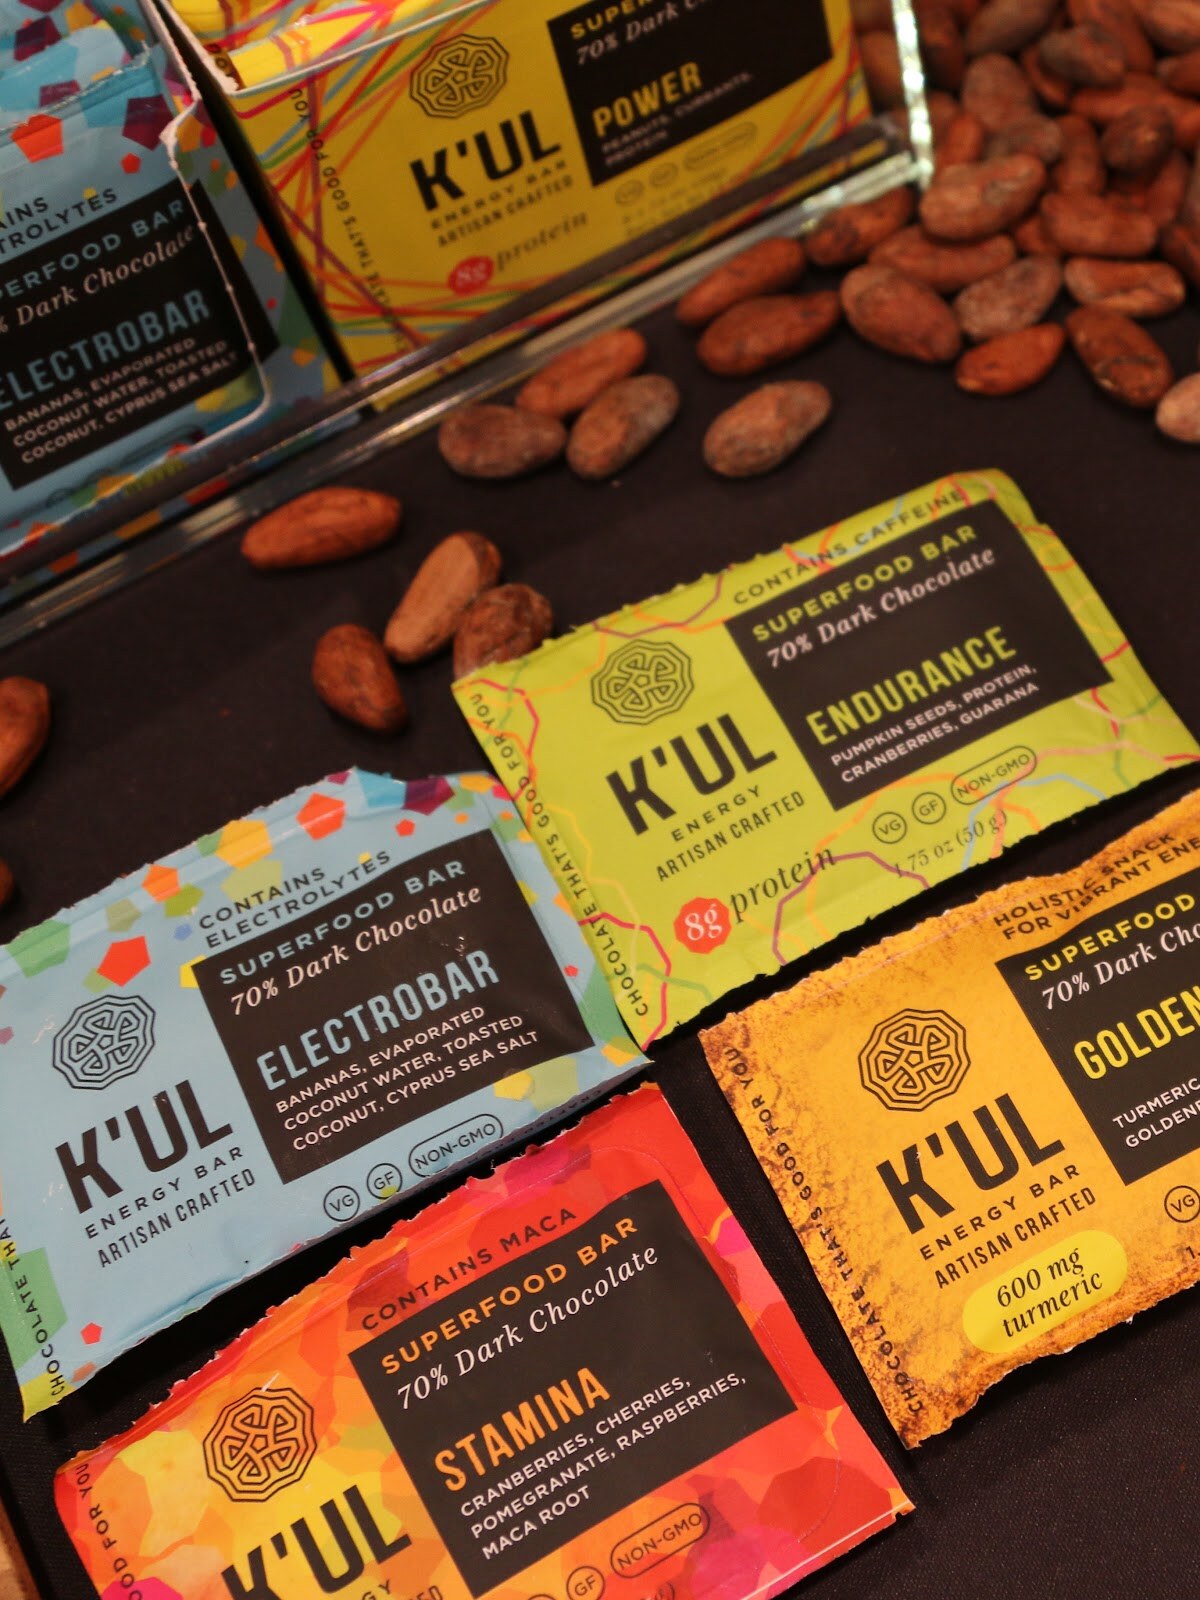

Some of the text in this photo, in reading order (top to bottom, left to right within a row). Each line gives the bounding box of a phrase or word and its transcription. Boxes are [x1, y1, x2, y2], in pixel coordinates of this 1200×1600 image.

[592, 61, 702, 137] POWER
[306, 128, 351, 213] GOOD FOR
[410, 110, 560, 211] K'UL
[431, 160, 567, 231] ENERGY BAR
[131, 200, 186, 239] BAR
[438, 206, 504, 248] ARTISAN
[17, 225, 196, 327] Dark Chocolate
[13, 340, 229, 449] COCONUT TOASTED
[89, 337, 196, 391] EVAPORATED
[105, 352, 237, 425] CYPRUS SEA SALT
[732, 488, 967, 606] CONTAINS CAFFEINE
[751, 524, 978, 643] SUPERFOOD BAR
[766, 547, 996, 670] 70% Dark Chocolate
[805, 626, 1017, 747] ENDURANCE
[831, 663, 1039, 767] PUMPKIN SEEDS, PROTEIN,
[840, 682, 1040, 783] CRANBERRIES, GUARANA
[605, 712, 778, 837] K'UL
[670, 785, 762, 842] ENERGY
[878, 752, 1031, 836] VG GF NON-GMO
[469, 692, 650, 1019] CHOCOLATE THAT'S GOOD FOR YOU
[655, 790, 806, 882] ARTISAN CRAFTED
[993, 832, 1176, 929] HOLISTIC SNACK
[198, 867, 327, 930] CONTAINS
[204, 850, 392, 949] ELECTROLYTES
[219, 860, 467, 986] SUPERFOOD BAR
[684, 847, 838, 942] 8g protein
[1002, 916, 1052, 942] FOR
[1053, 861, 1156, 927] VIBRANT
[1023, 893, 1197, 982] SUPERFOOD
[230, 887, 483, 1016] 70% Dark Chocolate
[1041, 975, 1091, 1011] 70%
[1098, 943, 1158, 986] Dark
[256, 949, 500, 1092] ELECTROBAR
[275, 1005, 486, 1115] BANANAS, EVAPORATED
[283, 1014, 524, 1132] COCONUT WATER, TOASTED
[292, 1030, 539, 1152] COCONUT, CYPRUS SEA SALT
[53, 1079, 235, 1215] K'UL
[84, 1145, 245, 1240] ENERGY BAR
[329, 1121, 498, 1214] VG GF NON-GMO
[874, 1092, 1066, 1236] K'UL
[95, 1166, 257, 1269] ARTISAN CRAFTED
[722, 1046, 926, 1415] CHOCOLATE THAT'S GOOD FOR YOU
[918, 1162, 1082, 1262] ENERGY BAR
[933, 1186, 1098, 1290] ARTISAN CRAFTED
[1170, 1193, 1197, 1216] VG
[360, 1206, 579, 1332] CONTAINS MACA
[379, 1216, 640, 1377] SUPERFOOD BAR
[995, 1247, 1086, 1310] 600 mg
[1001, 1268, 1105, 1340] turmeric
[14, 1274, 66, 1398] CHOCOLATE
[396, 1245, 661, 1411] 70% Dark Chocolate
[432, 1366, 613, 1493] STAMINA
[459, 1373, 693, 1519] CRANBERRIES, CHERRIES,
[470, 1371, 748, 1540] POMEGRANATE, RASPBERRIES,
[75, 1462, 118, 1551] FOR YOU
[220, 1484, 413, 1600] K'UL
[481, 1483, 593, 1561] MACA ROOT
[573, 1574, 598, 1598] GF
[616, 1510, 704, 1572] NON-GMO
